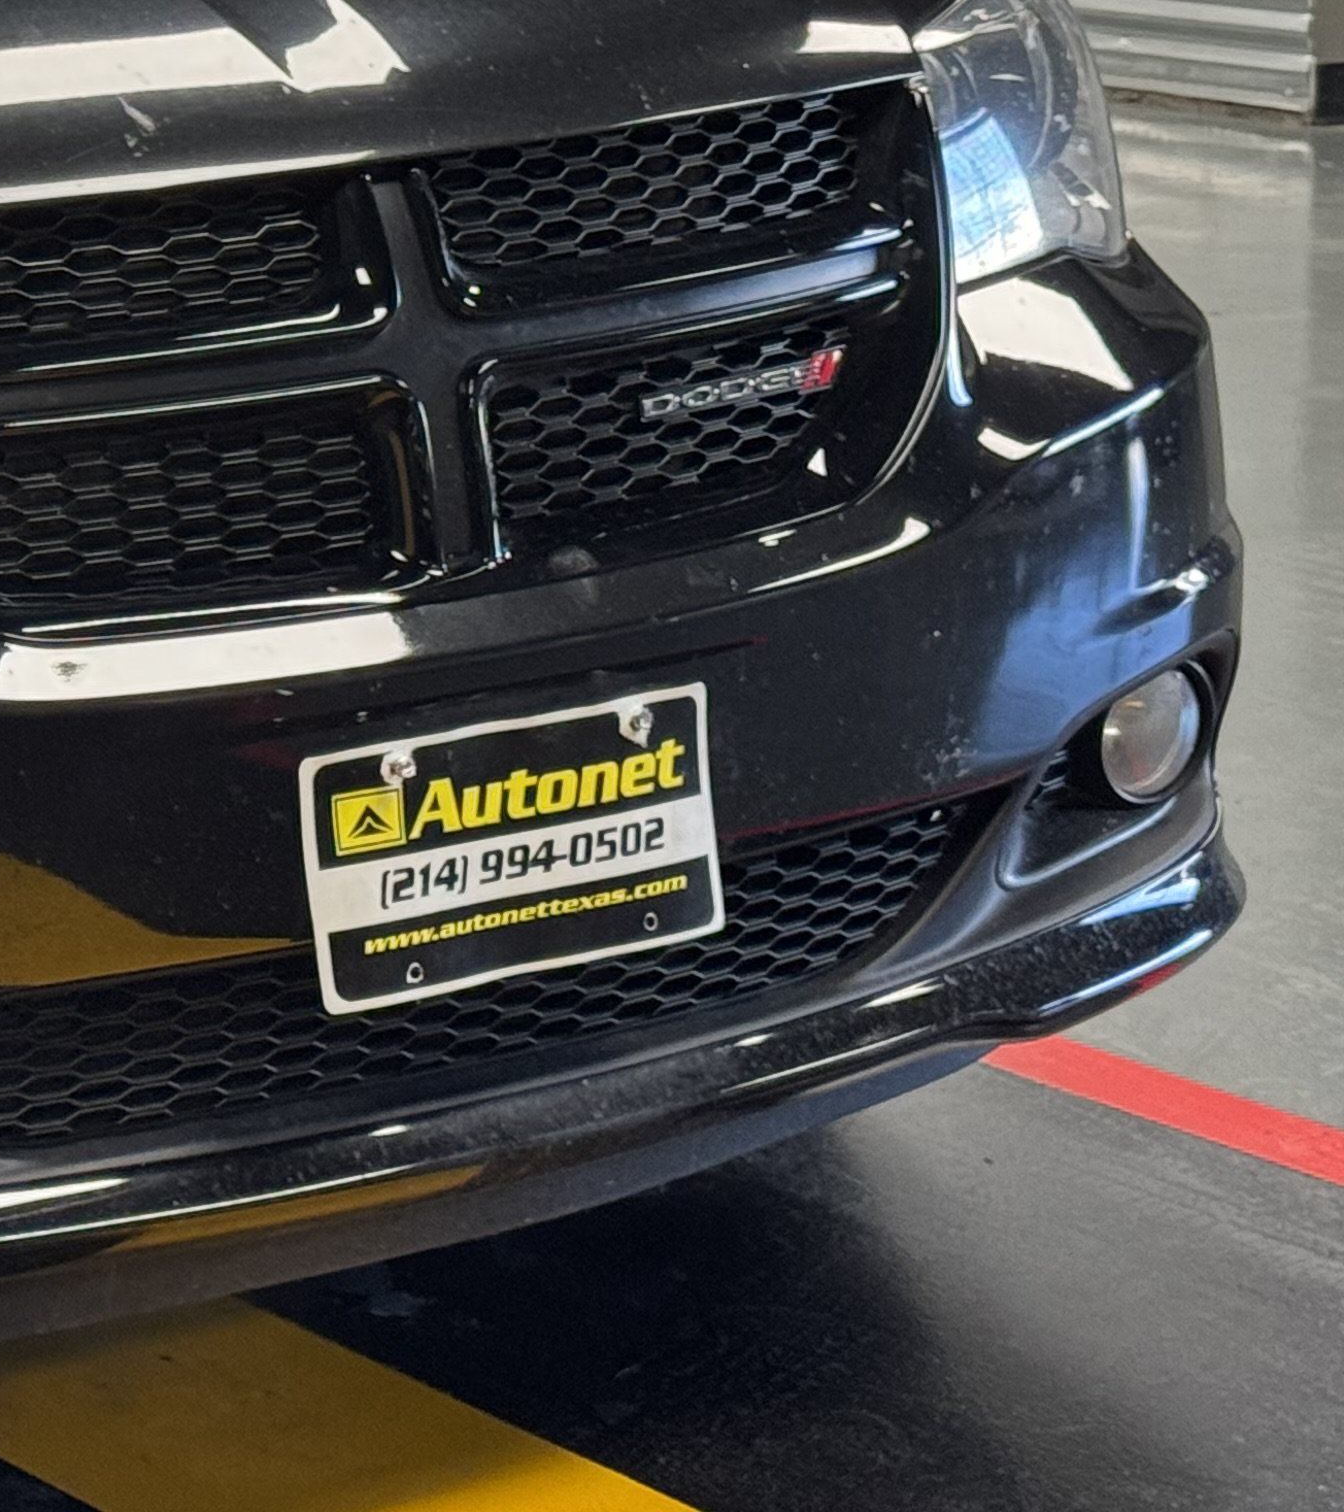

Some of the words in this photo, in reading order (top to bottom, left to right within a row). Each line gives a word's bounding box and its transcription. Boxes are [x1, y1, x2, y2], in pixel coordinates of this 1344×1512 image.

[640, 364, 806, 422] DODGE
[409, 738, 687, 840] Autonet
[380, 855, 469, 910] (214)
[479, 817, 665, 886] 994-0502
[363, 874, 688, 956] www.autonettexas.com
